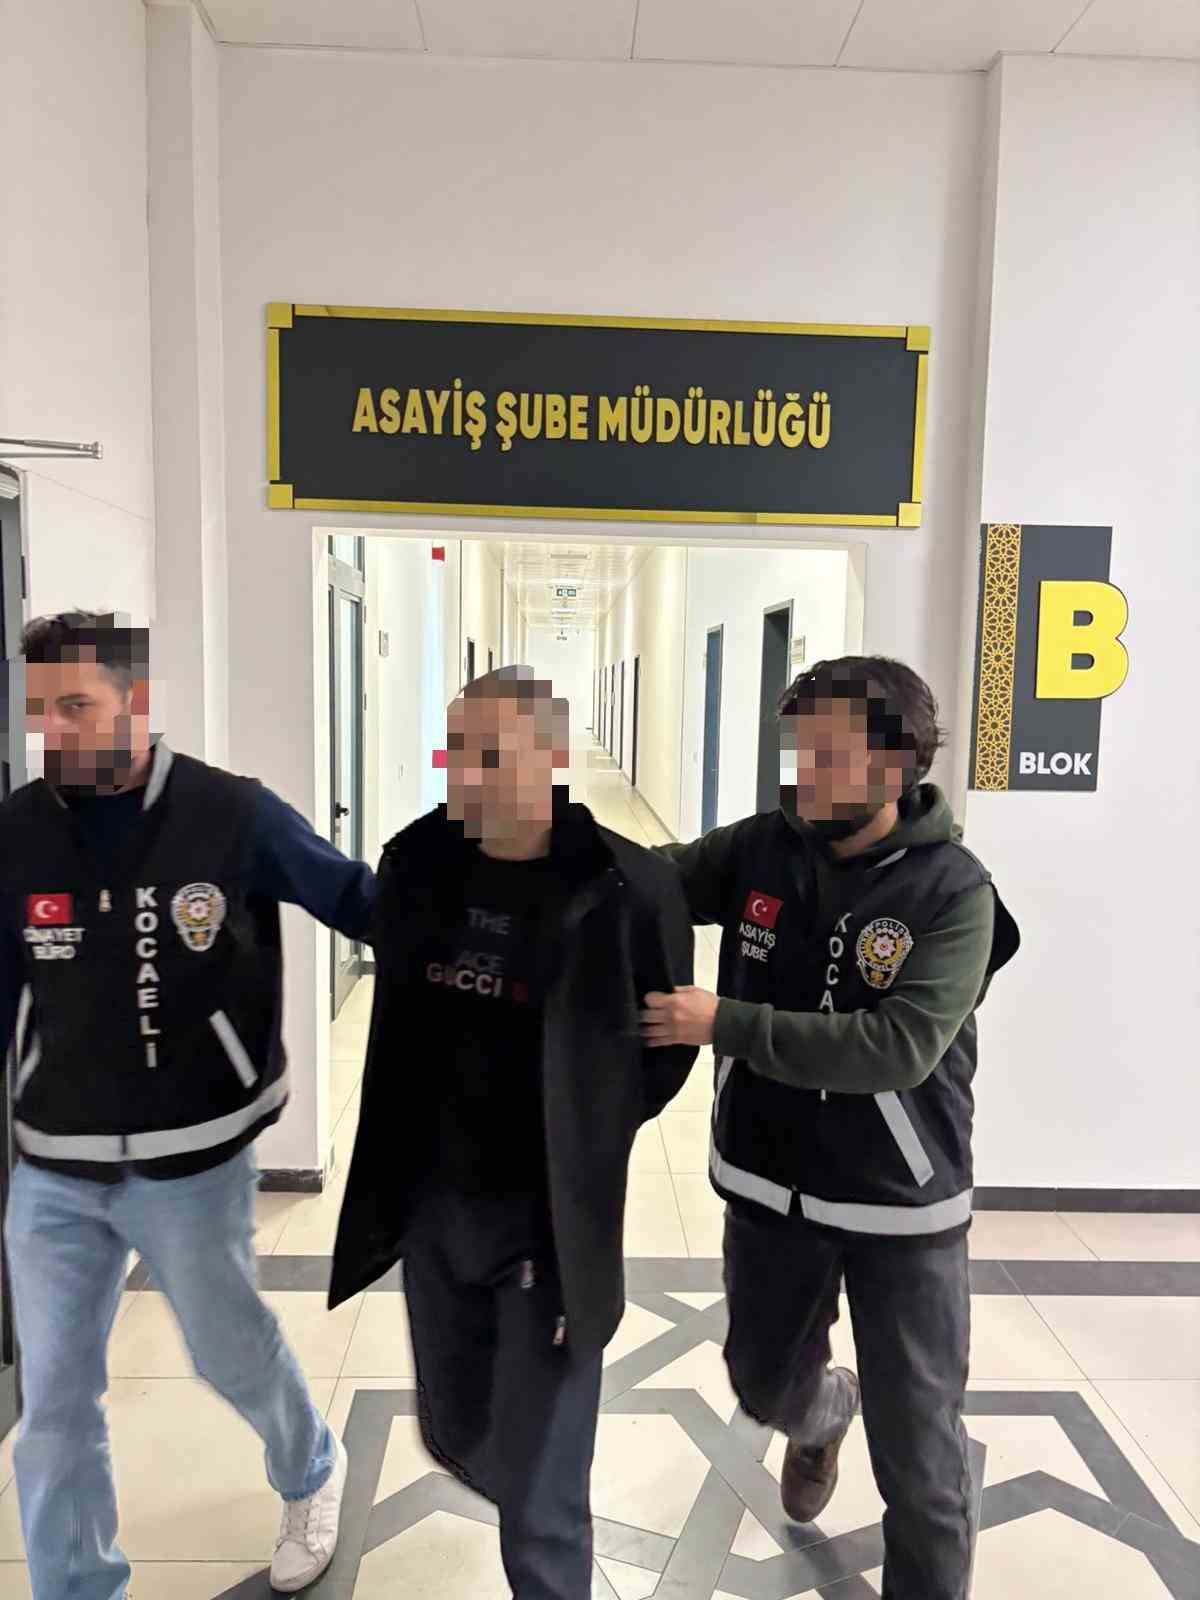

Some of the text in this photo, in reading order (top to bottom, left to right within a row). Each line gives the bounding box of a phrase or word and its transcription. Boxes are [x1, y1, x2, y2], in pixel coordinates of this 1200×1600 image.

[352, 378, 831, 451] ASAYİŞ ŞUBE MÜDÜRLÜĞÜ
[1035, 580, 1129, 700] B
[1019, 751, 1092, 776] BLOK
[466, 907, 512, 935] THE
[739, 921, 776, 950] ASAYİŞ
[741, 941, 769, 963] ŞUBE
[819, 912, 852, 1101] KOCA
